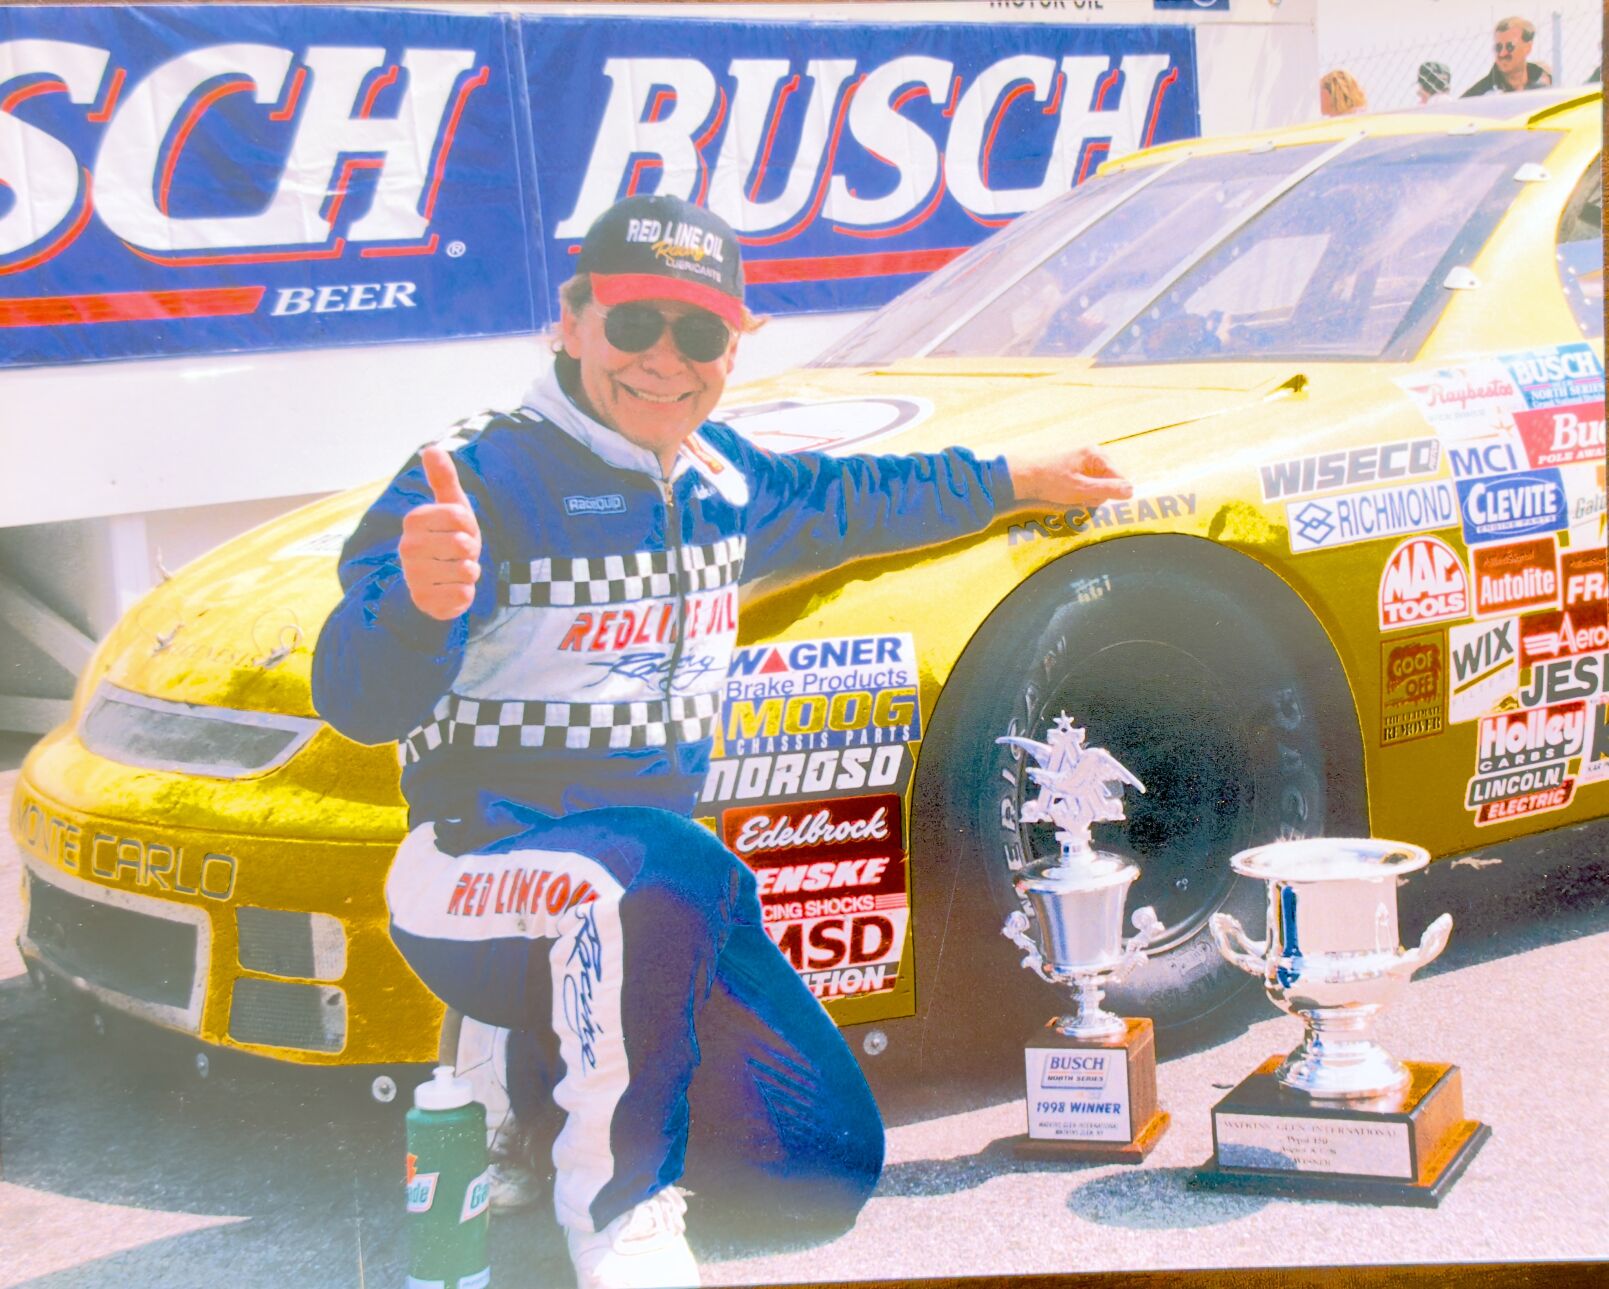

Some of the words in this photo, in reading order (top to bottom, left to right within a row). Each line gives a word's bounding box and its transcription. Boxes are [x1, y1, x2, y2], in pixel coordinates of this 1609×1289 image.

[554, 54, 1170, 241] BUSCH
[626, 218, 661, 243] RED
[663, 220, 703, 249] LINE
[703, 232, 724, 264] OIL
[271, 281, 417, 317] BEER
[1510, 351, 1600, 386] BUSCH
[1426, 379, 1514, 409] Raybestos
[1260, 438, 1439, 500] WISECO
[1448, 443, 1519, 477] MCI
[1537, 452, 1574, 465] POLE
[1336, 483, 1452, 538] RICHMOND
[1467, 482, 1558, 525] CLEVITE
[1384, 541, 1464, 604] MAC
[1480, 567, 1556, 606] Autolite
[1384, 592, 1465, 622] TOOLS
[1452, 620, 1514, 682] WIX
[727, 676, 795, 699] Brake
[802, 667, 908, 692] Products
[726, 686, 917, 741] MOOG
[736, 732, 830, 756] CHASSIS
[845, 724, 911, 747] PARTS
[1480, 708, 1585, 760] Holley
[1479, 748, 1555, 772] CARBS
[1473, 766, 1562, 802] LINCOLN
[1487, 788, 1567, 819] ELECTRIC
[735, 806, 889, 853] Edelbrock
[91, 831, 238, 903] CARLO
[447, 870, 494, 917] RED
[804, 895, 875, 917] SHOCKS
[1050, 1056, 1104, 1070] BUSCH
[1037, 1101, 1066, 1113] 1998
[1070, 1102, 1122, 1114] WINNER
[1224, 1121, 1271, 1130] WATKINS
